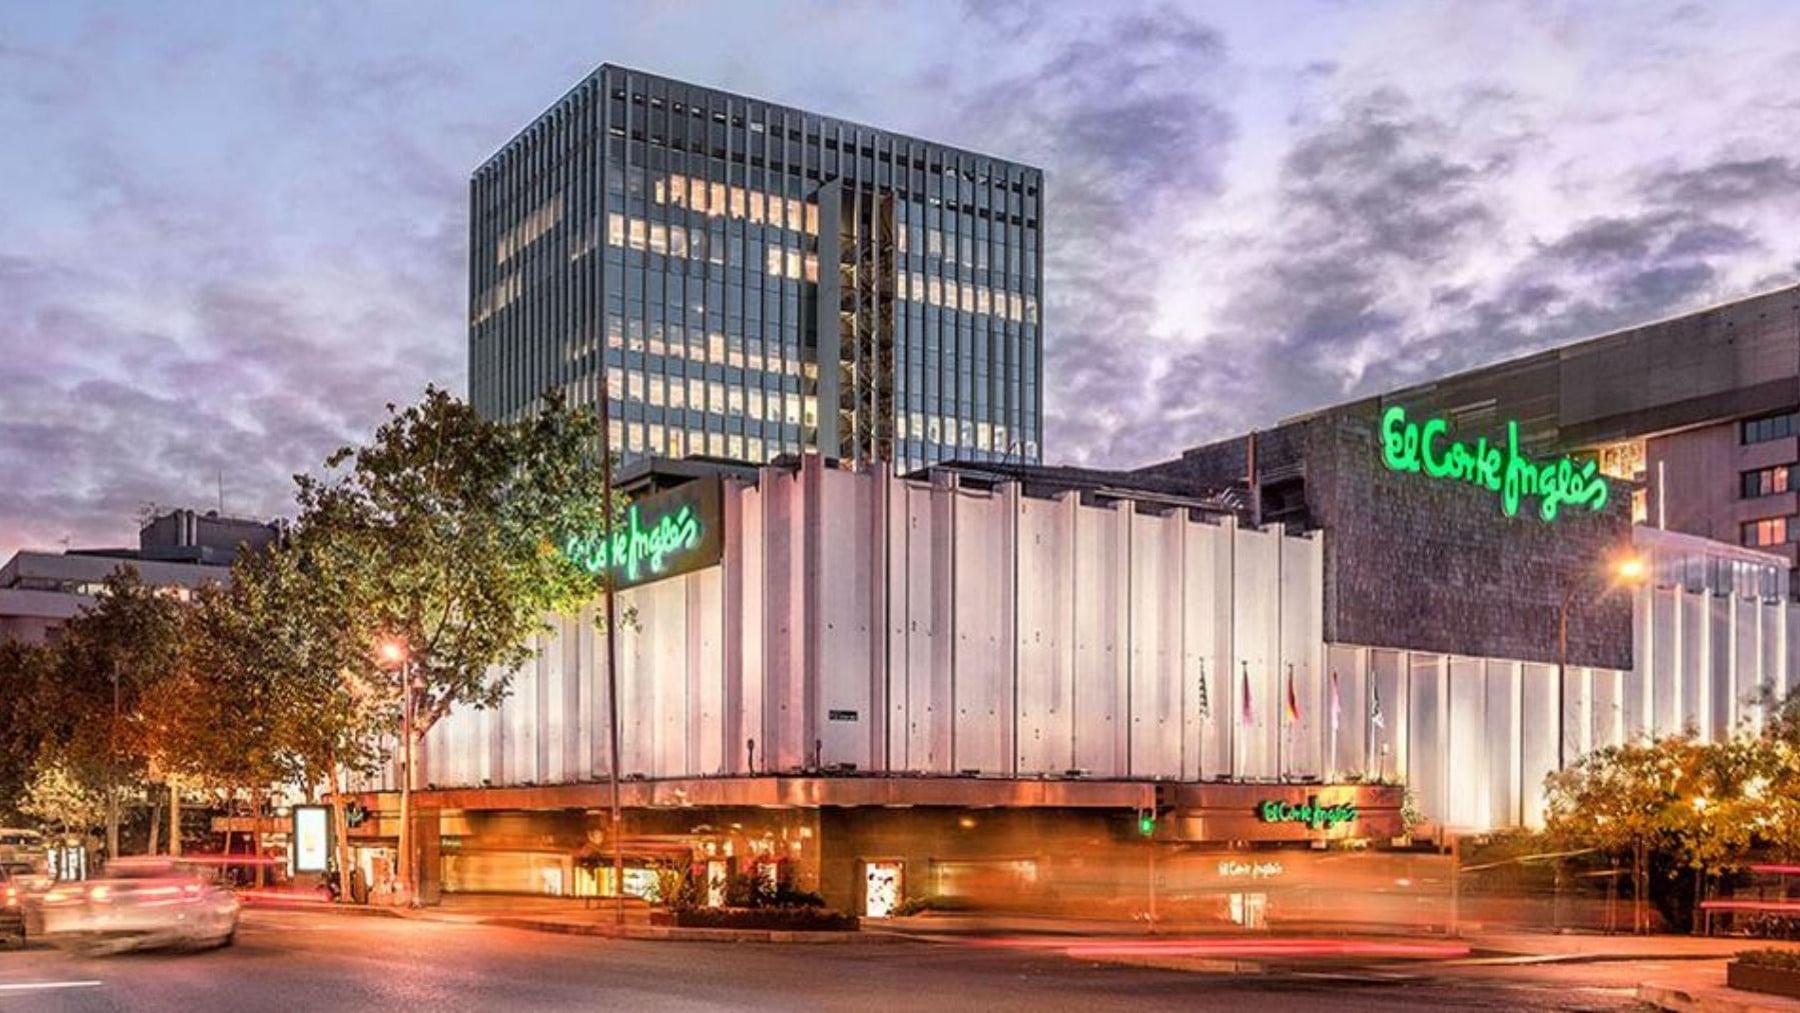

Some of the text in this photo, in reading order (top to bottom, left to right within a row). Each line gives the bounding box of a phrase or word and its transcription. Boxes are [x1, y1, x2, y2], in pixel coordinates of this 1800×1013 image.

[1381, 406, 1607, 521] El Corte Inglés
[627, 505, 698, 581] Inglés
[1261, 800, 1280, 822] El
[1279, 801, 1311, 821] Corte
